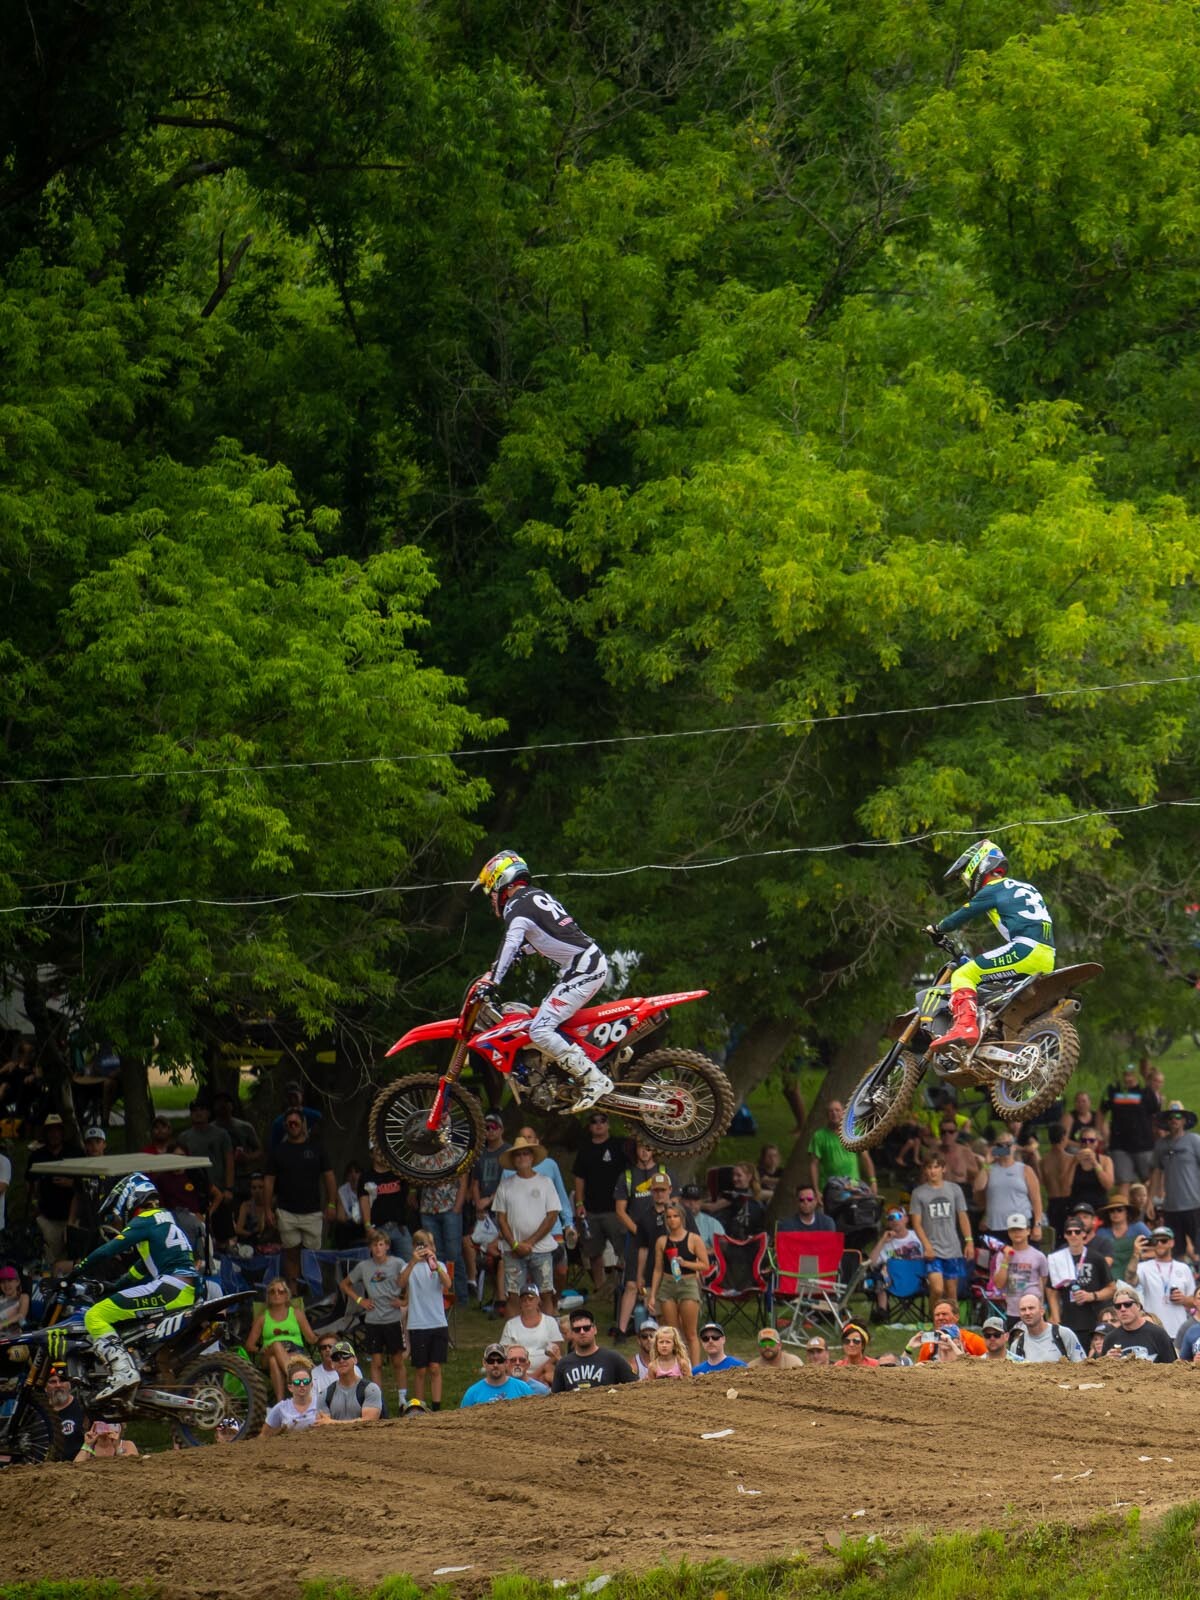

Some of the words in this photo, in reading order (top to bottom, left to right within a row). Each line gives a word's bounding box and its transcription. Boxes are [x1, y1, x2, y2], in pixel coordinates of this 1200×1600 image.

[990, 969, 1017, 980] YAMAHA
[598, 1005, 631, 1017] HONDA
[593, 1019, 628, 1047] 96
[929, 1202, 951, 1218] FLY
[566, 1364, 603, 1384] IOWA
